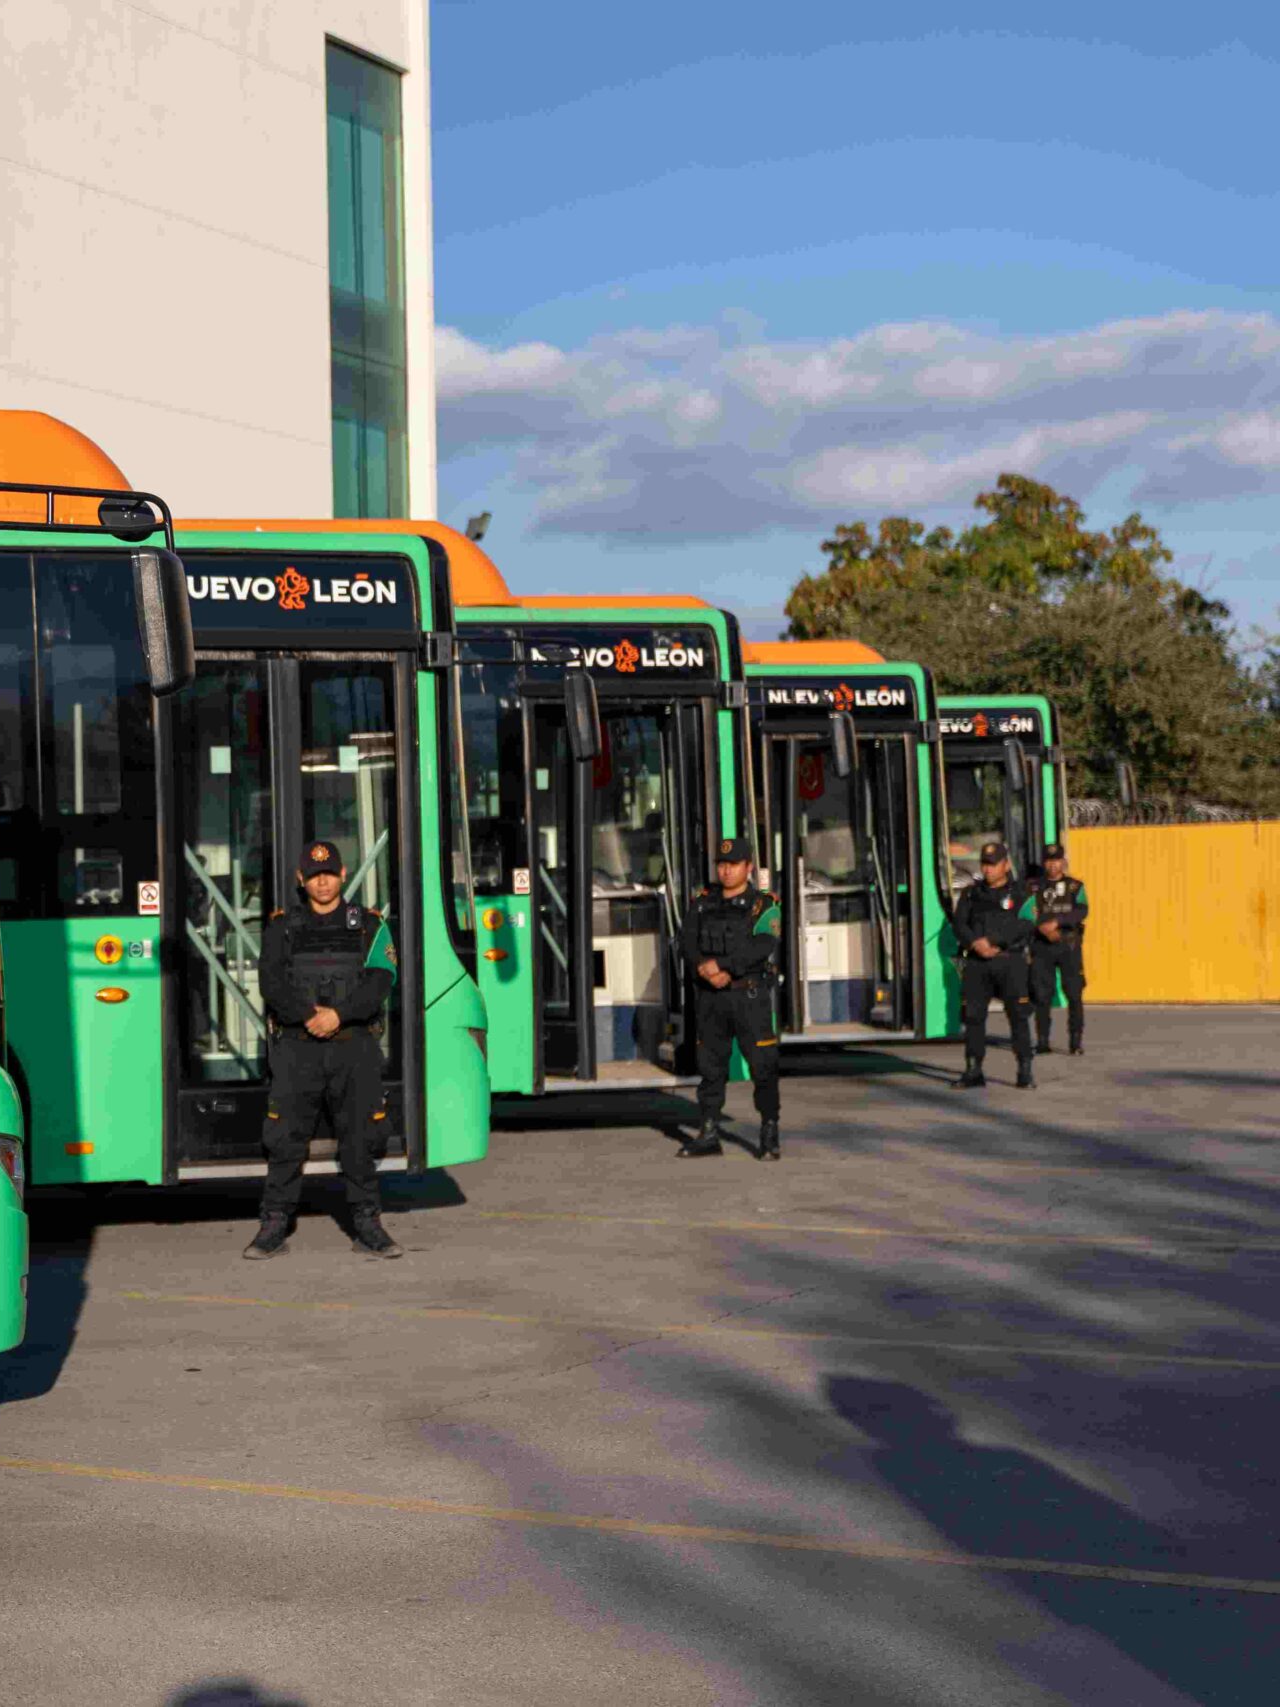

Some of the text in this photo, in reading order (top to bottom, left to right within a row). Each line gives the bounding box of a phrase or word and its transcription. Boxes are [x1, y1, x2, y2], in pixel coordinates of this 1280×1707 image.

[186, 573, 397, 603] UEVO LEÓN
[641, 642, 704, 667] LEÓN
[855, 685, 906, 706] LEÓN
